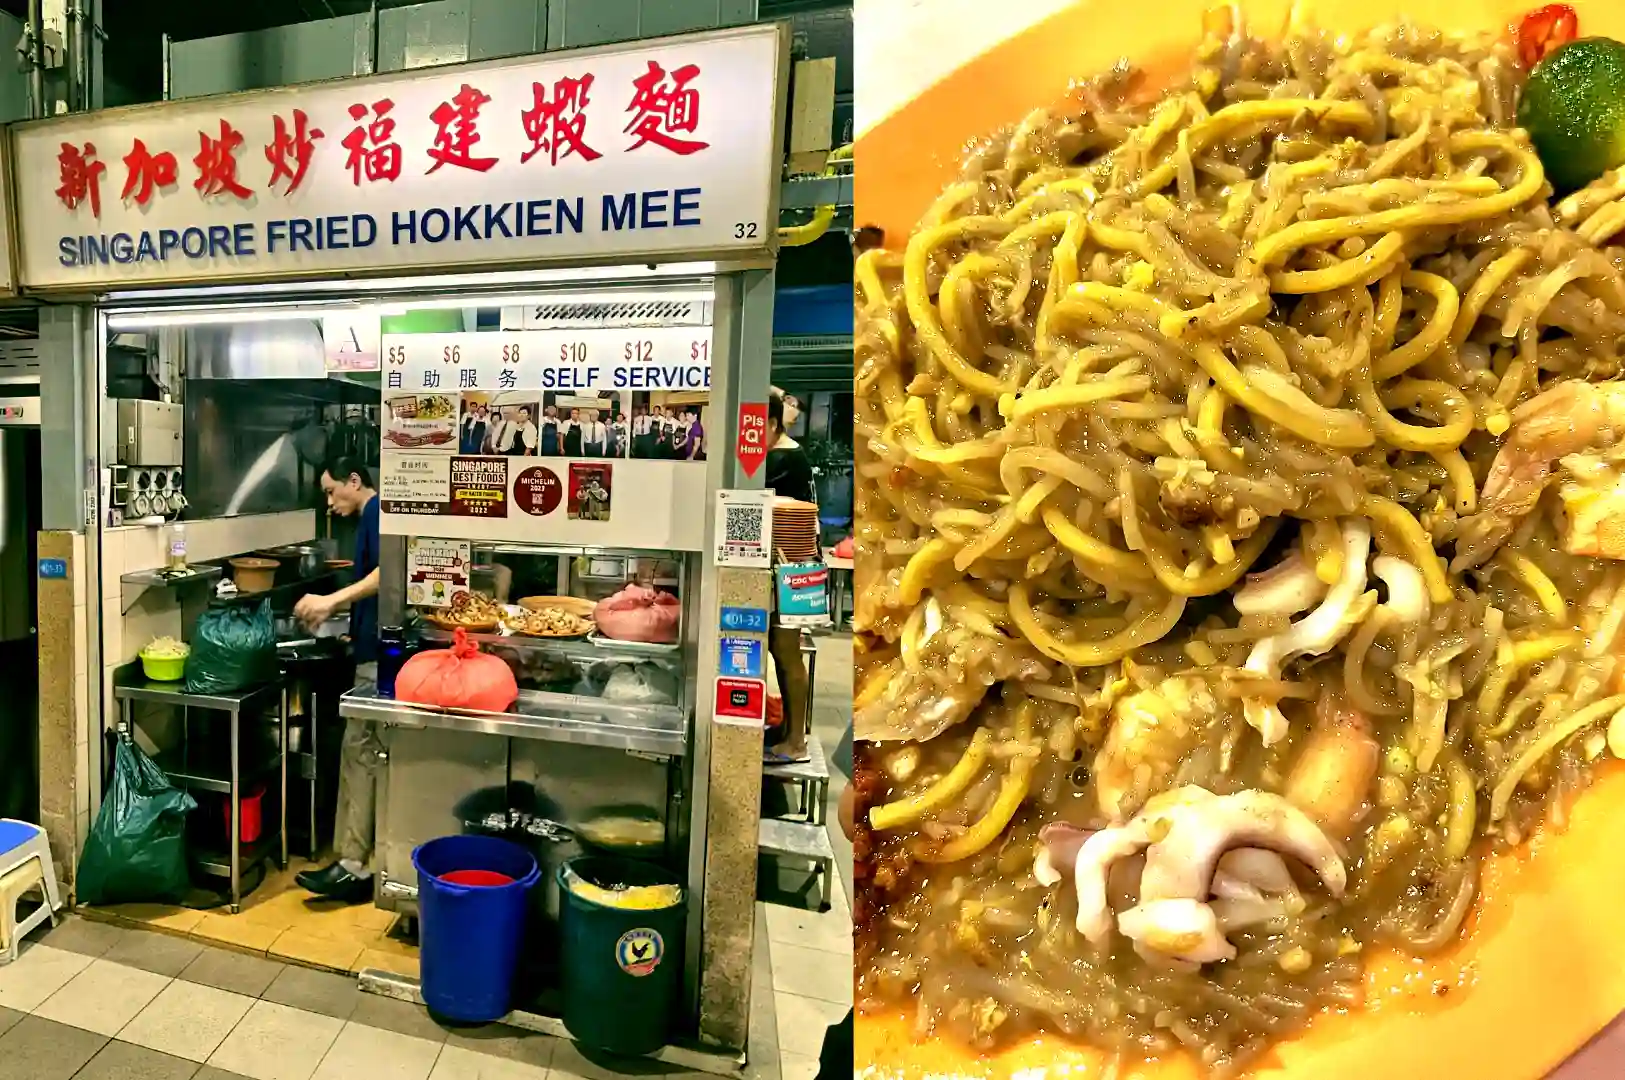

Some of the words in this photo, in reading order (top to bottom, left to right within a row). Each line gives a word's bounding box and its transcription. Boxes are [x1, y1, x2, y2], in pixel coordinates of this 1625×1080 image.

[55, 60, 711, 218] 新加坡炒福建蝦麵
[58, 222, 256, 268] SINGAPORE
[266, 213, 378, 254] FRIED
[391, 196, 584, 245] HOKKIEN
[601, 187, 702, 232] MEE
[734, 222, 758, 240] 32
[388, 345, 406, 366] $5
[443, 344, 461, 365] $6
[502, 343, 521, 365] $8
[560, 341, 588, 363] $10
[624, 340, 654, 363] $12
[388, 368, 518, 389] 自助服务
[542, 366, 600, 388] SELF
[743, 414, 765, 427] Pls
[740, 445, 763, 455] Here
[452, 460, 506, 473] SINGAPORE
[453, 472, 474, 482] BEST
[476, 473, 504, 483] FOODS
[470, 506, 488, 514] 2022
[732, 613, 761, 627] 01-32
